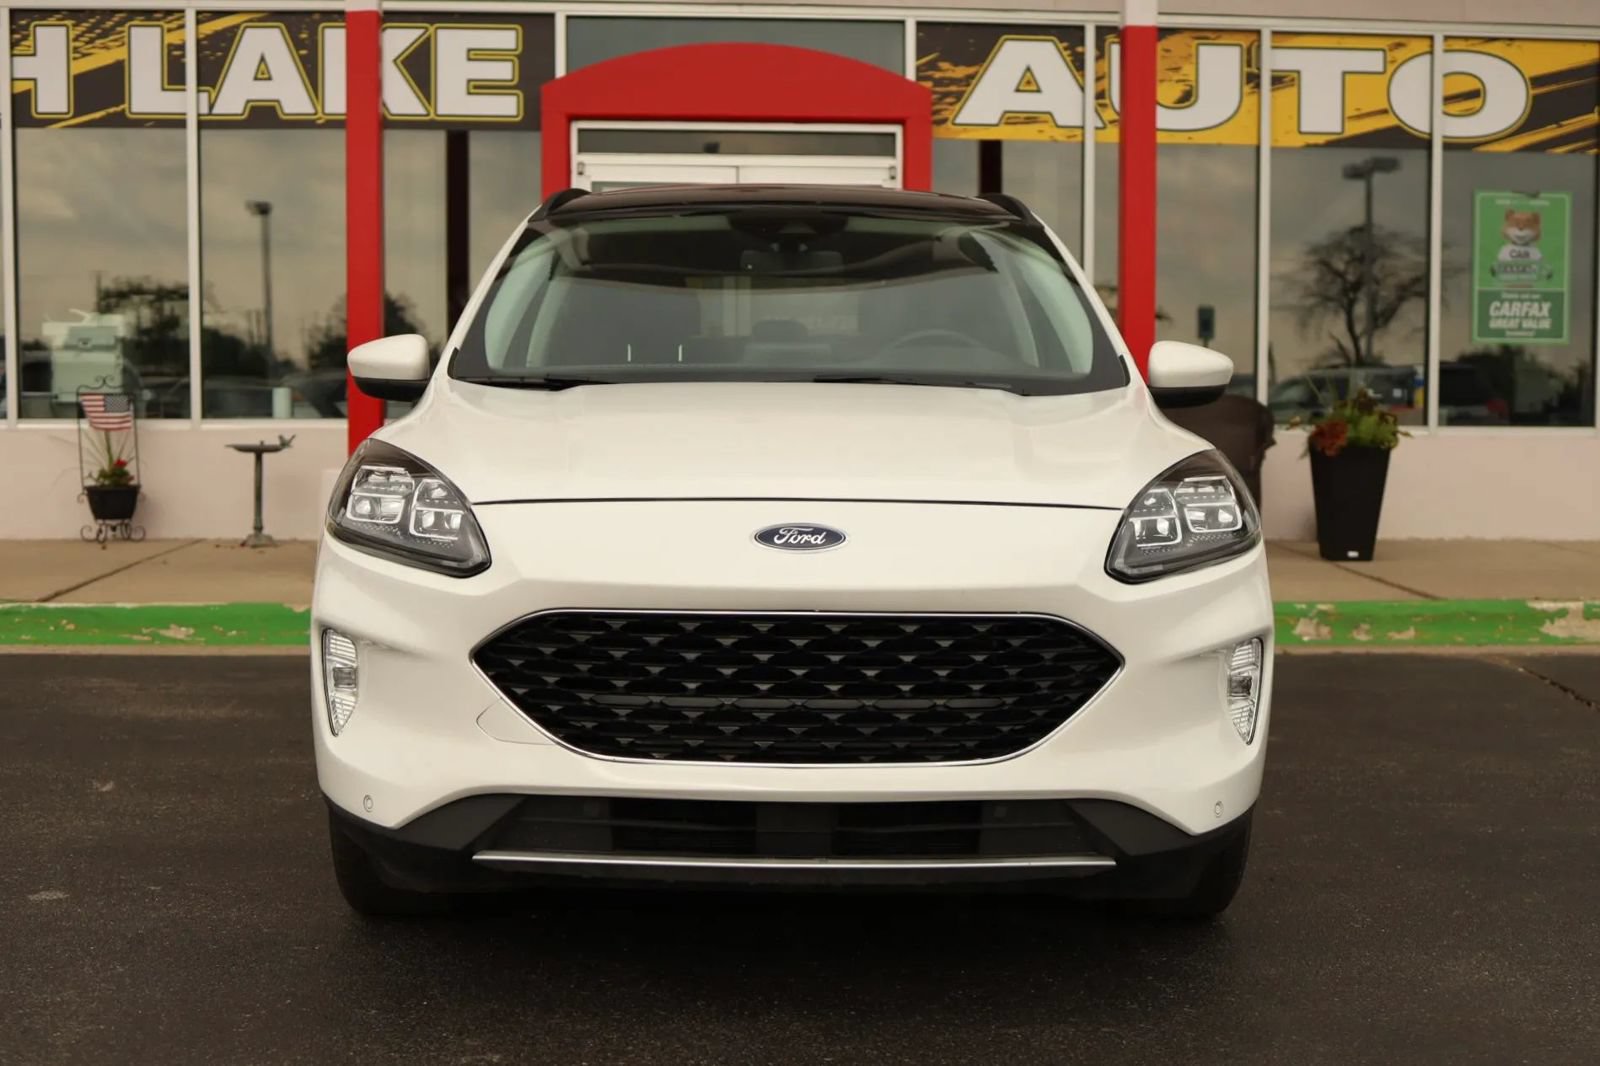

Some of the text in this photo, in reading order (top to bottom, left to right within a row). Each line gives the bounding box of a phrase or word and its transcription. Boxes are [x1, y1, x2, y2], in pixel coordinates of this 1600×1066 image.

[125, 22, 523, 122] LAKE
[950, 35, 1532, 140] AUTO
[1489, 301, 1552, 317] CARFAX
[773, 527, 827, 544] Ford
